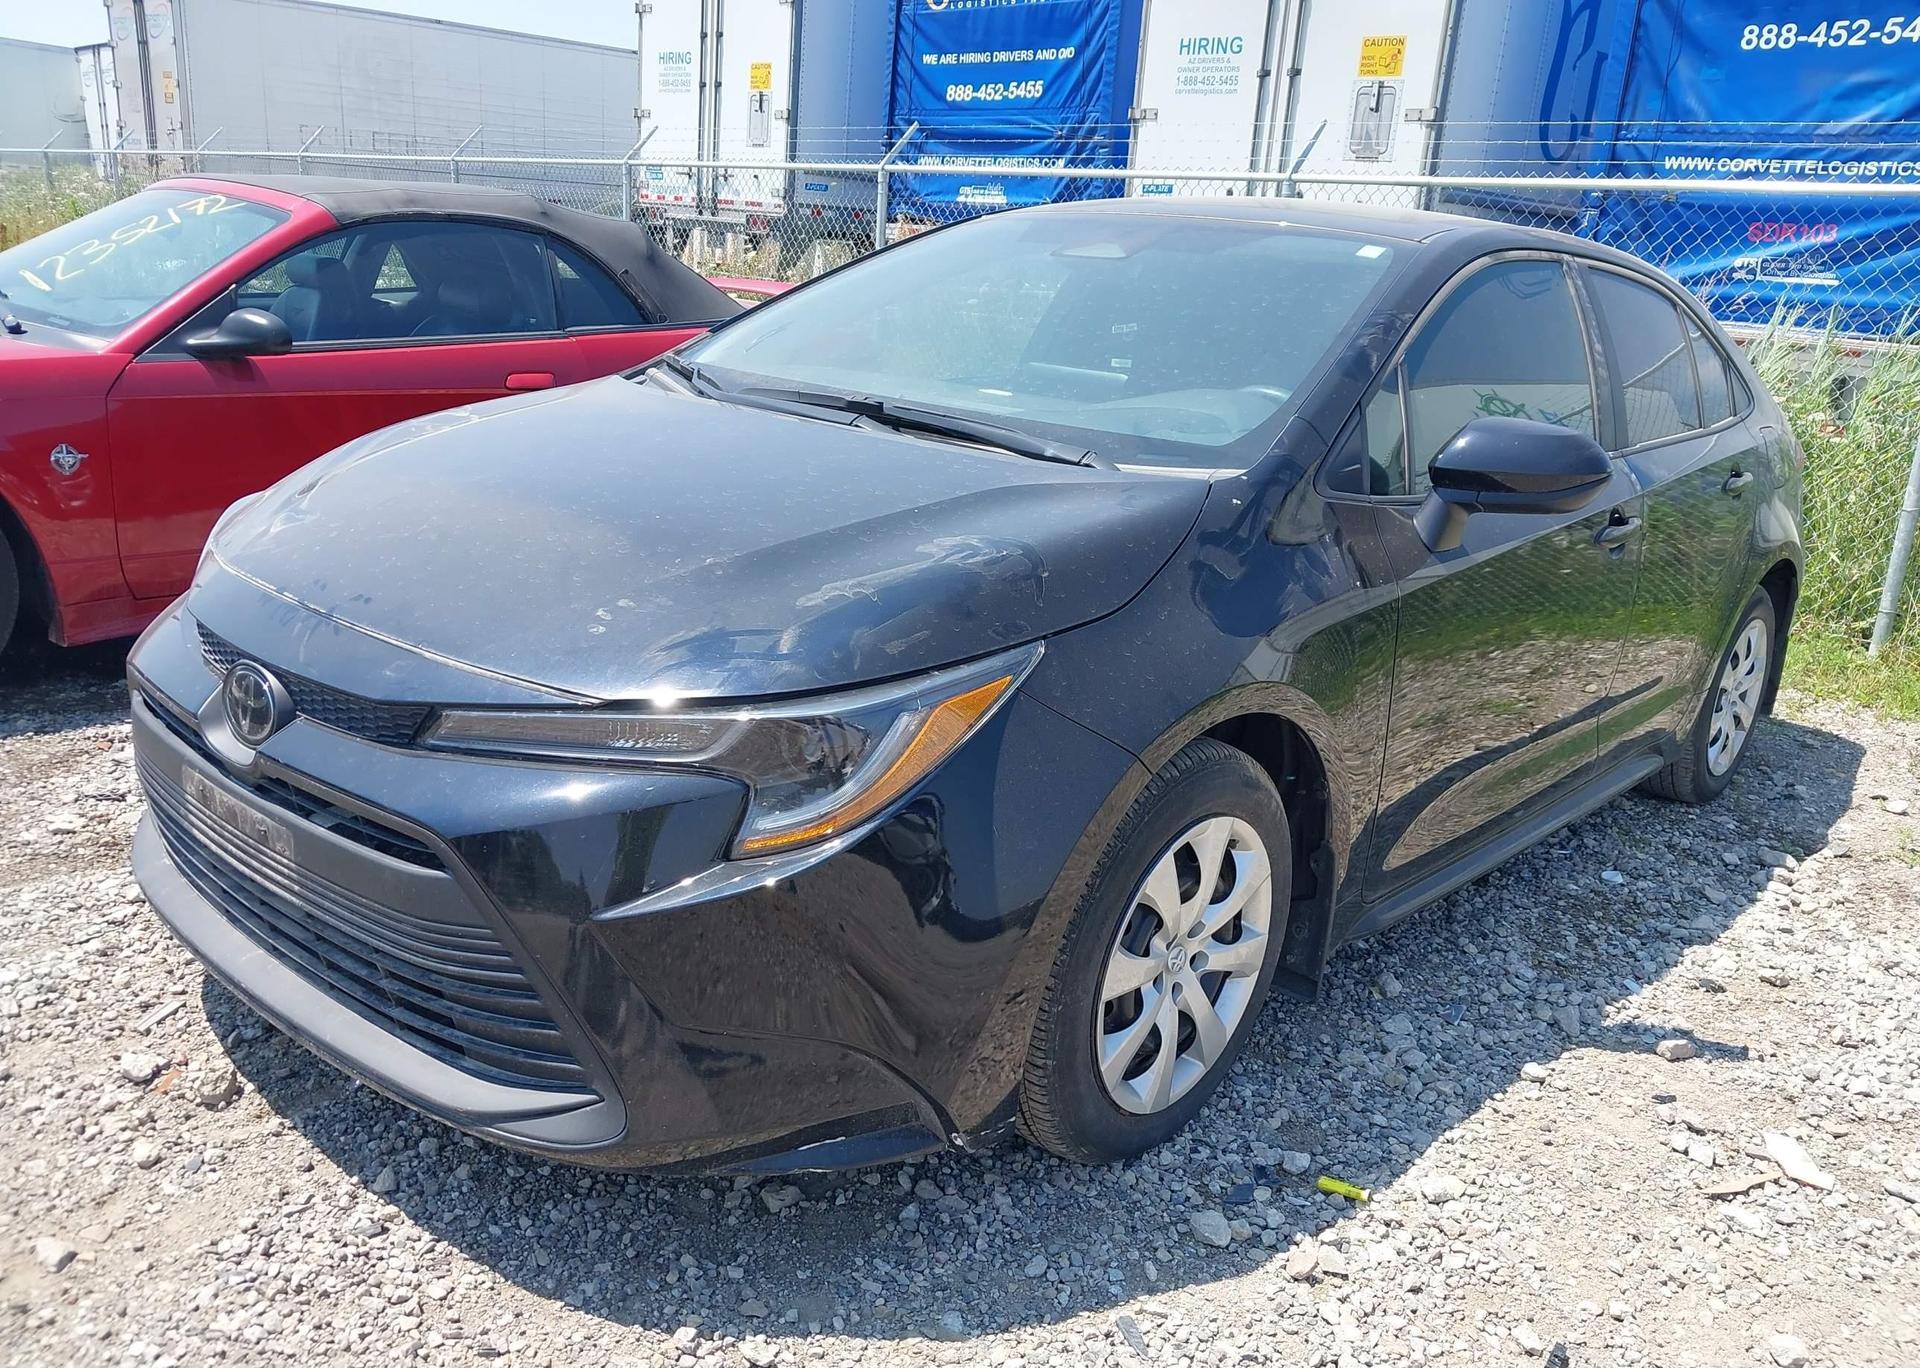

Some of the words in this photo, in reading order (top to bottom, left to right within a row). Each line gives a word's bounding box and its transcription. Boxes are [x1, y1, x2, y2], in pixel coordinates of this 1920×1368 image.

[1740, 16, 1920, 50] 888-452-54
[1179, 36, 1243, 55] HIRING
[1364, 37, 1404, 48] CAUTION
[658, 51, 692, 64] HIRING
[922, 54, 938, 65] WE
[939, 55, 958, 65] ARE
[959, 52, 991, 64] HIRING
[993, 50, 1034, 63] DRIVERS
[1035, 48, 1056, 61] AND
[1177, 75, 1239, 86] 1-888-452-5455
[946, 80, 1043, 101] 888-452-5455
